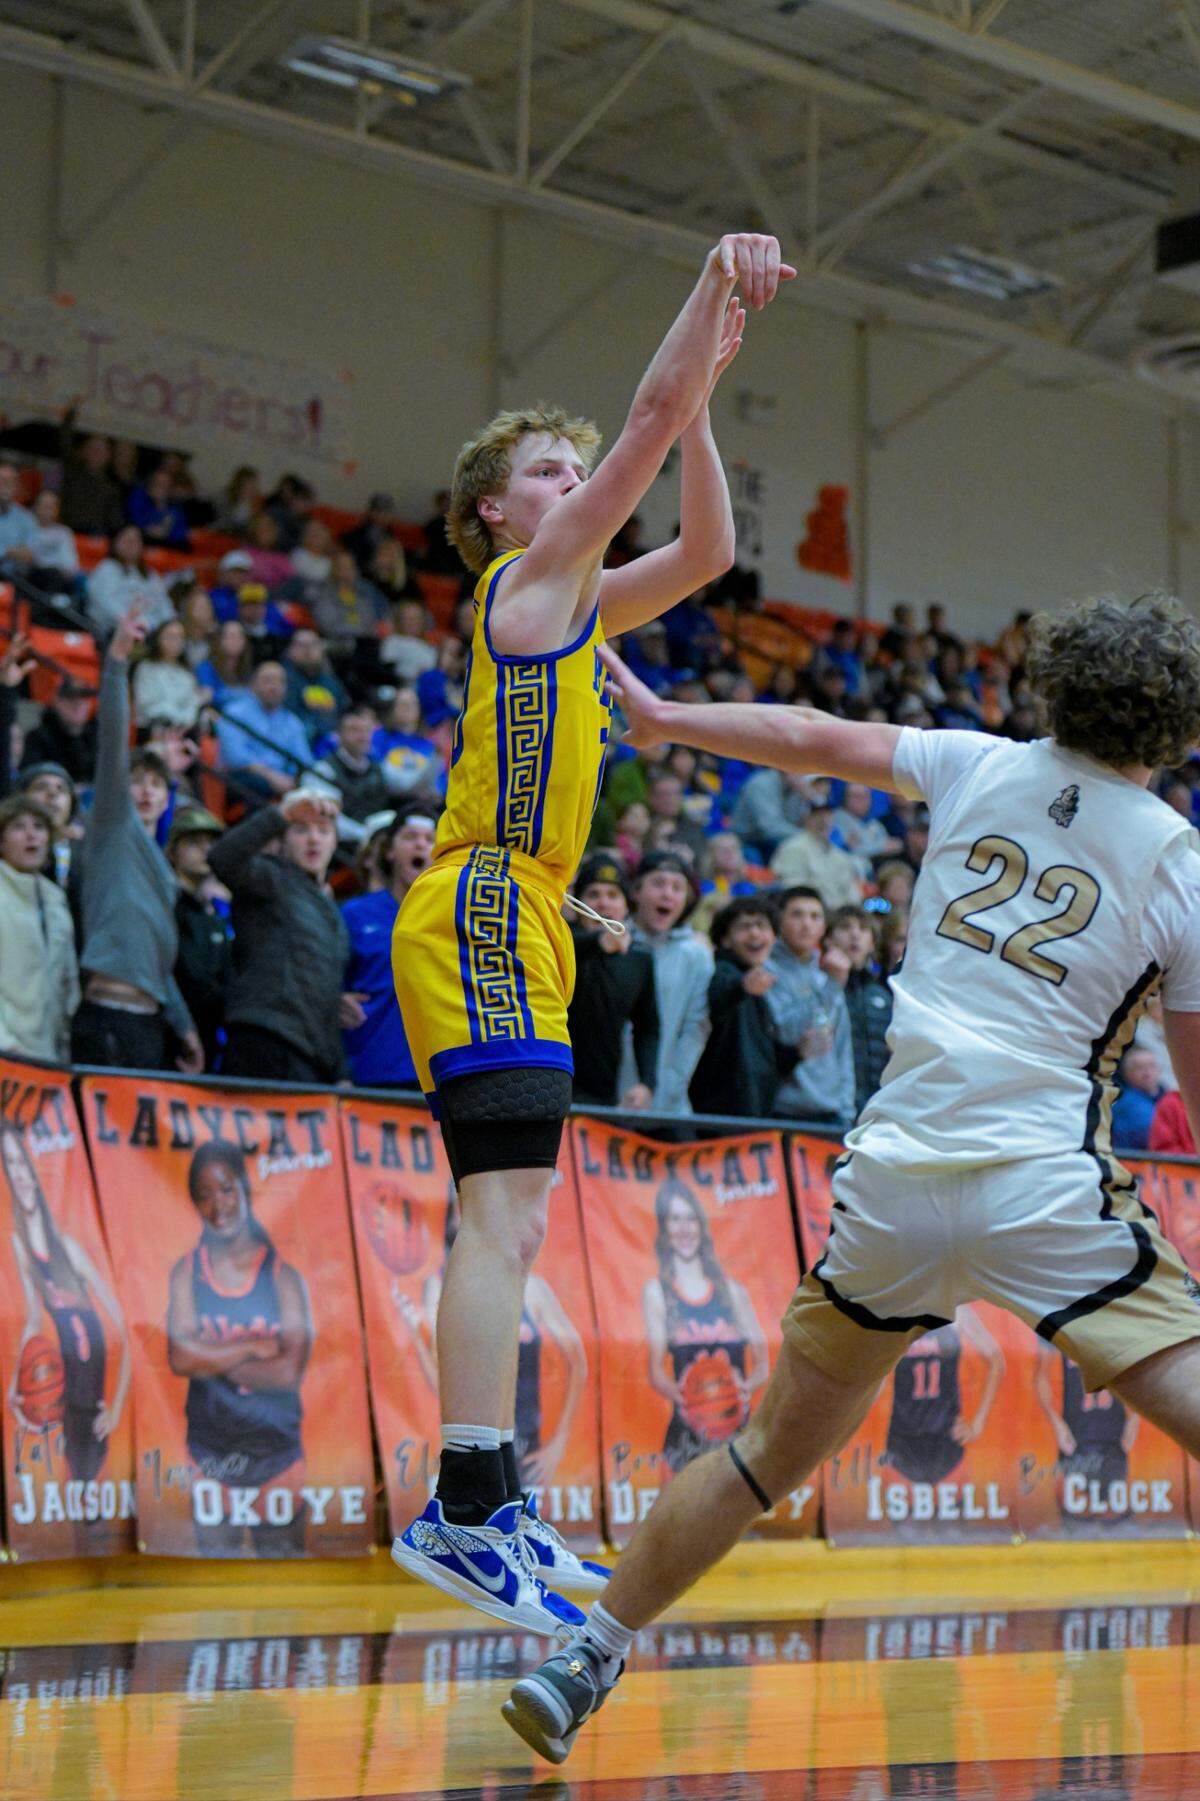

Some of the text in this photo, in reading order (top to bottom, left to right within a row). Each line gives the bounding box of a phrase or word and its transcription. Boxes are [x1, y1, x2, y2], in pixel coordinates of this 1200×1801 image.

[936, 834, 1100, 986] 22
[94, 1092, 327, 1156] LADYCAT
[579, 1128, 777, 1186] LADYCAT
[911, 1360, 942, 1399] 11
[193, 1478, 368, 1527] OKOYE
[866, 1475, 1009, 1521] ISBELL
[1062, 1473, 1174, 1514] CLOCK
